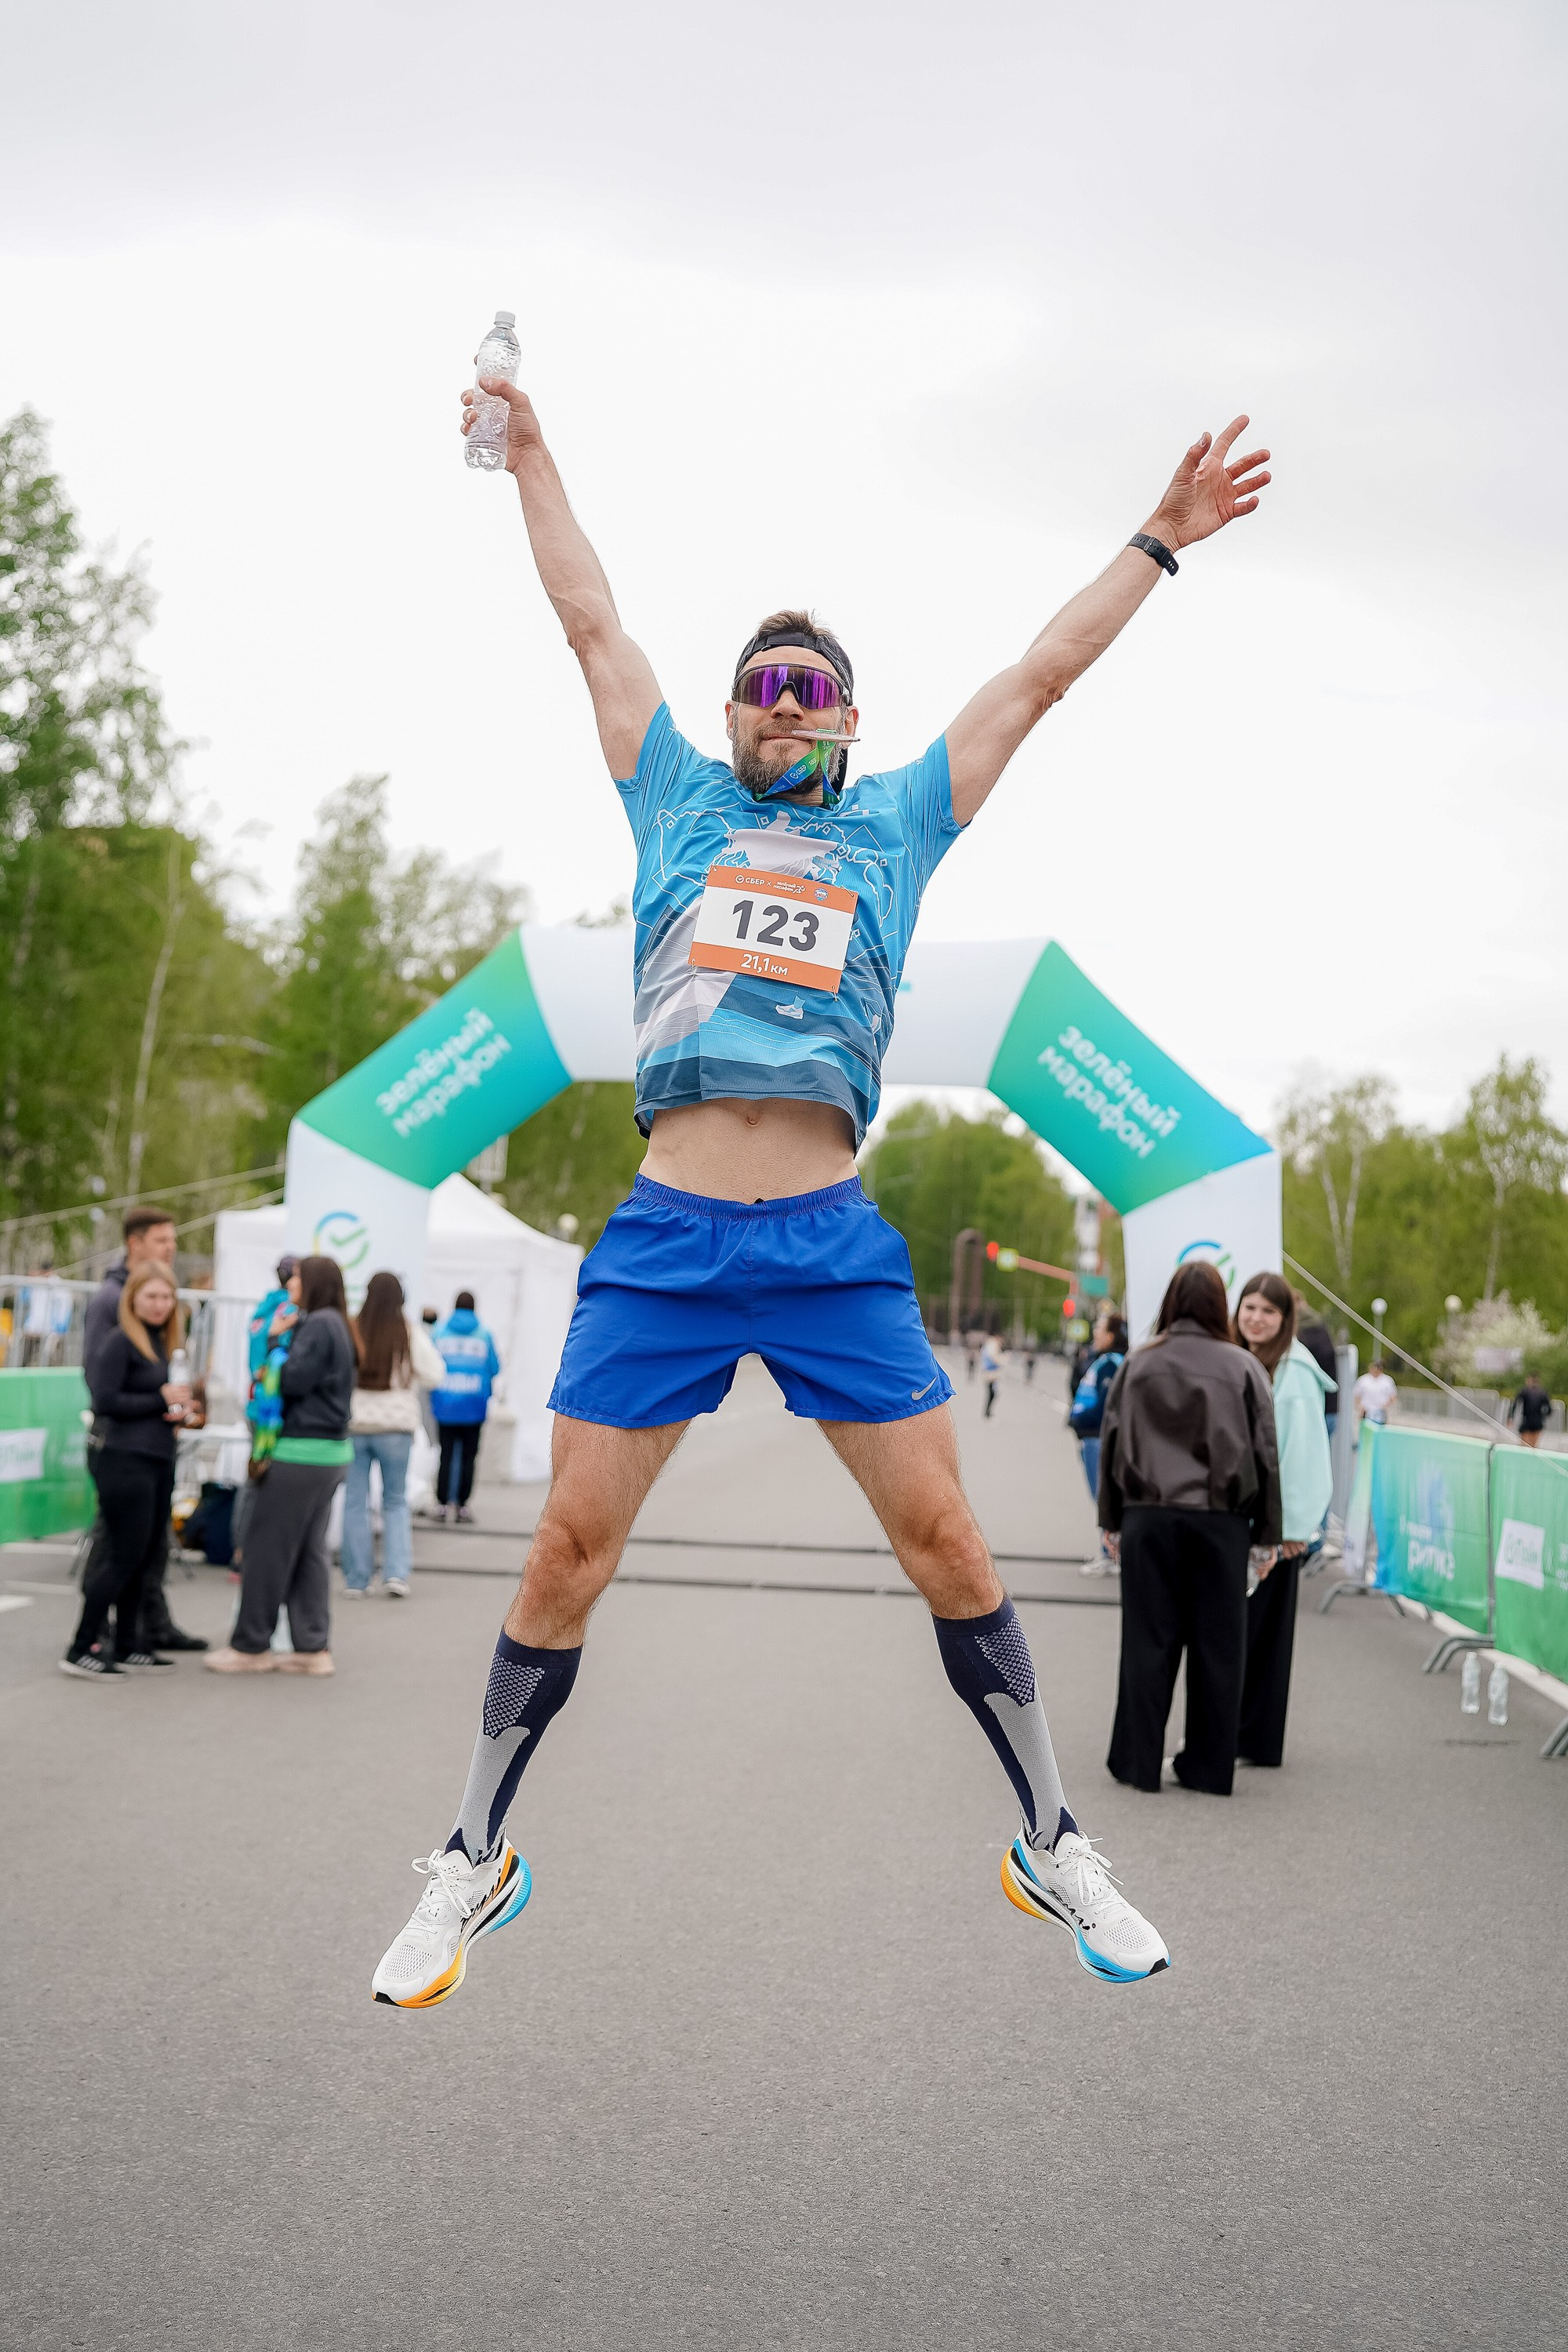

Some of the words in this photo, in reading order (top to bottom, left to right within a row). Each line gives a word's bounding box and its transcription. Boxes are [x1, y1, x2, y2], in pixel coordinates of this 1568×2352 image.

[732, 900, 819, 952] 123
[394, 1033, 511, 1137] марафон
[1037, 1045, 1156, 1159] марафон
[1058, 1025, 1181, 1137] зелёный
